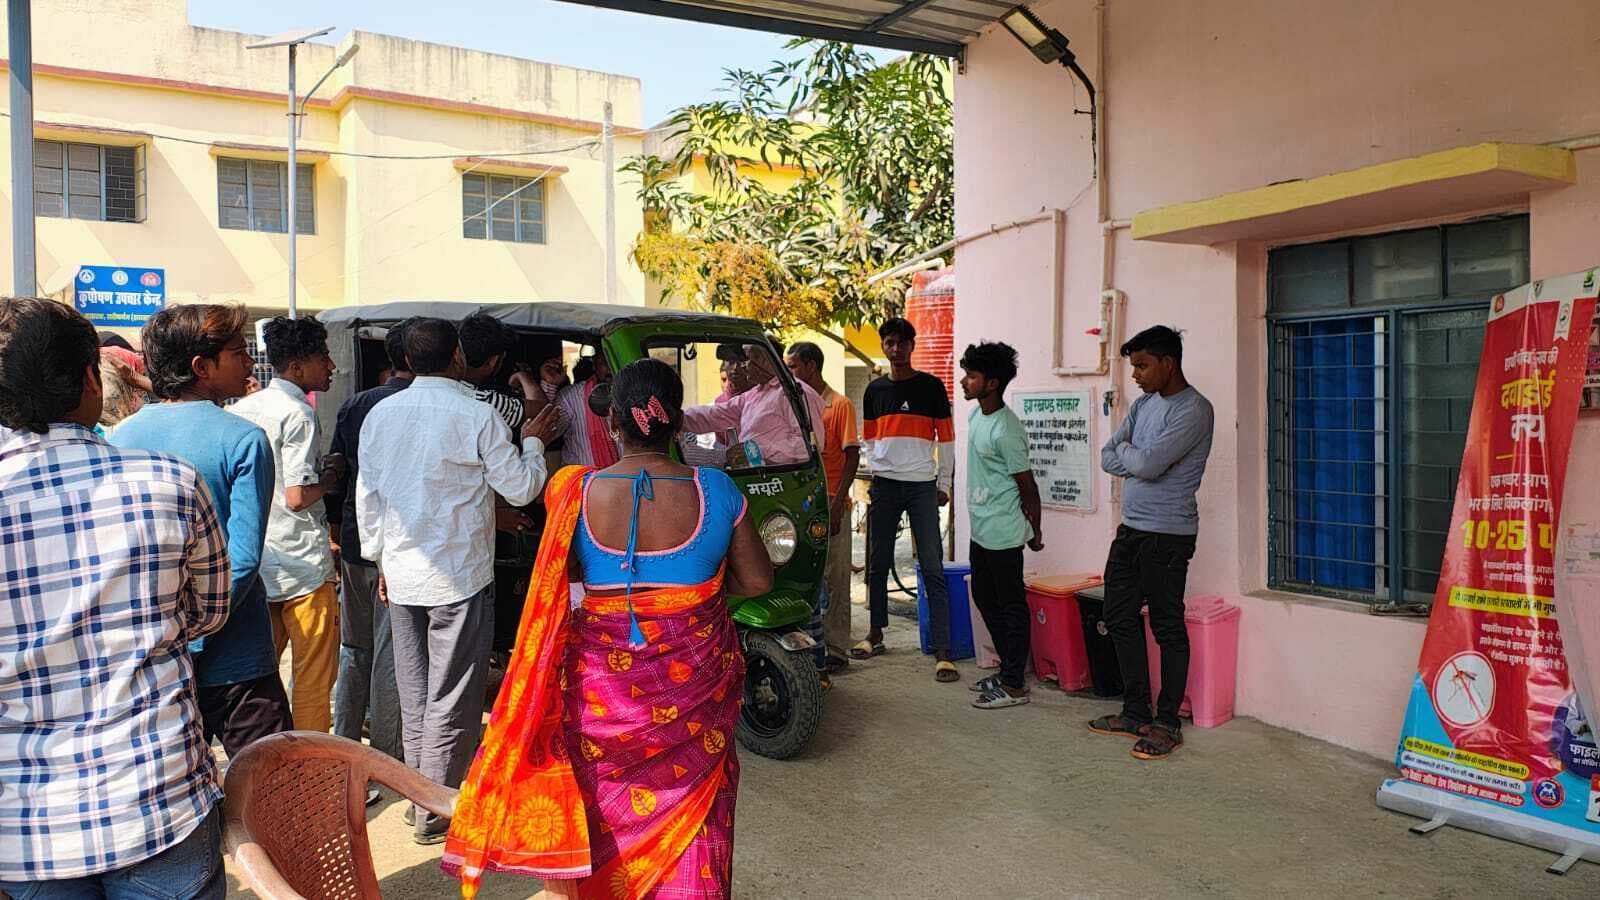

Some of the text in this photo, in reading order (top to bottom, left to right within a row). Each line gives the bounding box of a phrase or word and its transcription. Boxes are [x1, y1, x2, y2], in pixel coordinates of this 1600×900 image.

[77, 287, 113, 308] कुपोषण
[115, 291, 142, 306] उपचार
[1023, 398, 1081, 414] झारखण्ड सरकार
[1461, 519, 1528, 551] 10-25
